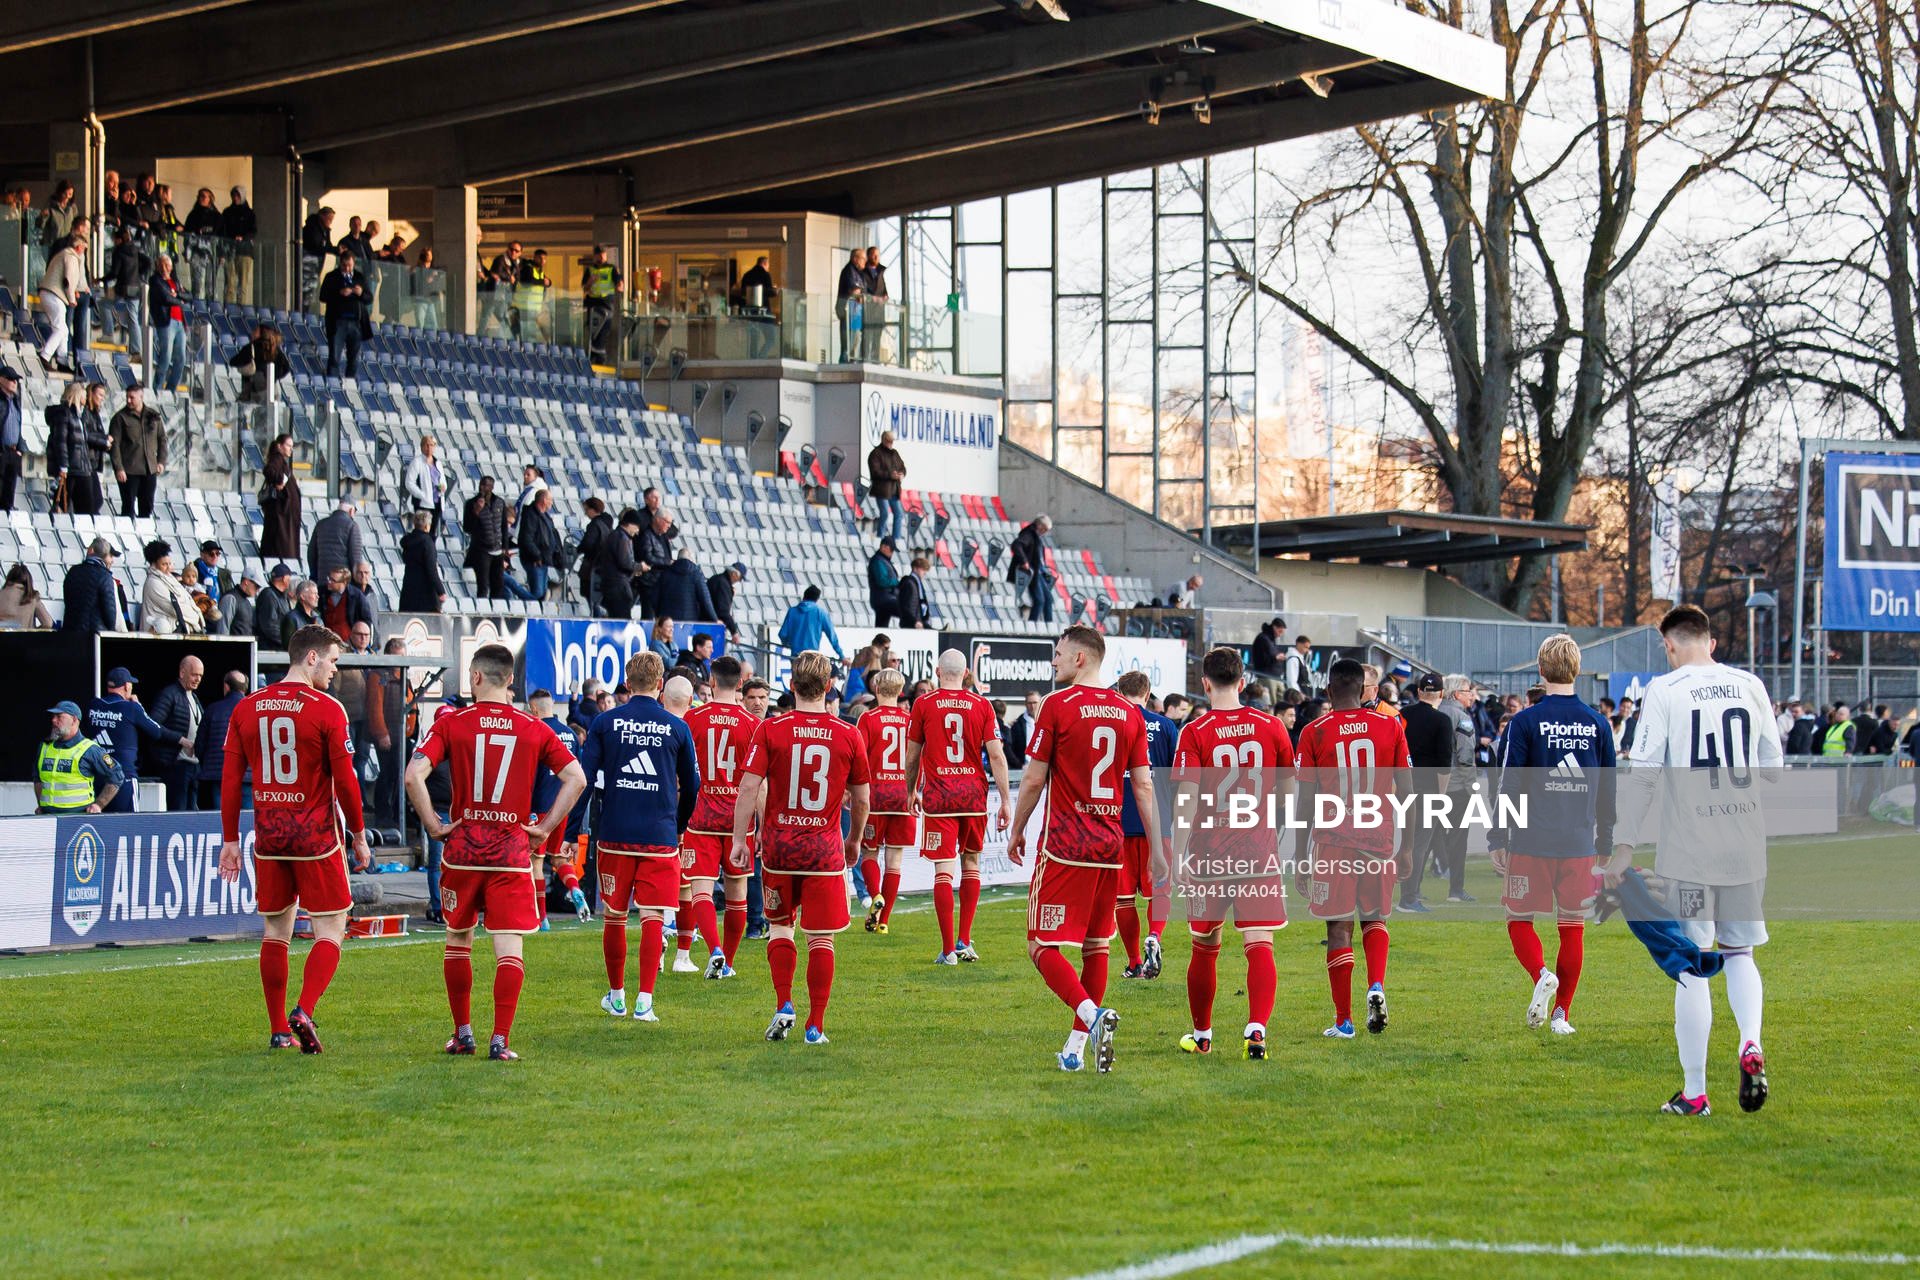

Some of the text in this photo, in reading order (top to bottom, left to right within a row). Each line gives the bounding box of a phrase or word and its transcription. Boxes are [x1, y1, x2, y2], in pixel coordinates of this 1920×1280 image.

[890, 402, 994, 449] MOTORHALLAND
[1870, 588, 1910, 617] Din
[907, 649, 934, 681] VVS
[981, 656, 1053, 682] HYDROSCAND
[1690, 684, 1743, 703] PICORNELL
[255, 698, 305, 714] BERGSTRÖM
[936, 699, 973, 710] DANIELSON
[1079, 706, 1128, 722] JOHANSSON
[89, 709, 123, 721] Prioritet
[479, 716, 513, 730] GRACIA
[613, 718, 672, 737] Prioritet
[793, 726, 833, 741] FINNDELL
[1215, 724, 1255, 740] WIKHEIM
[1339, 722, 1368, 736] ASORO
[1539, 721, 1597, 738] Prioritet
[621, 730, 663, 748] Finans
[944, 712, 965, 764] 3
[258, 716, 299, 785] 18
[707, 727, 737, 783] 14
[882, 725, 906, 771] 21
[1690, 707, 1752, 790] 40
[473, 733, 518, 804] 17
[1090, 726, 1117, 799] 2
[788, 743, 831, 812] 13
[883, 773, 906, 781] FXOR
[1212, 740, 1264, 813] 23
[1335, 738, 1376, 810] 10
[616, 778, 659, 792] stadium
[1544, 780, 1589, 793] stadium
[263, 791, 305, 803] FXORO
[473, 810, 518, 824] FXORO
[788, 816, 829, 827] FXORO
[108, 829, 258, 922] ALLSVENS
